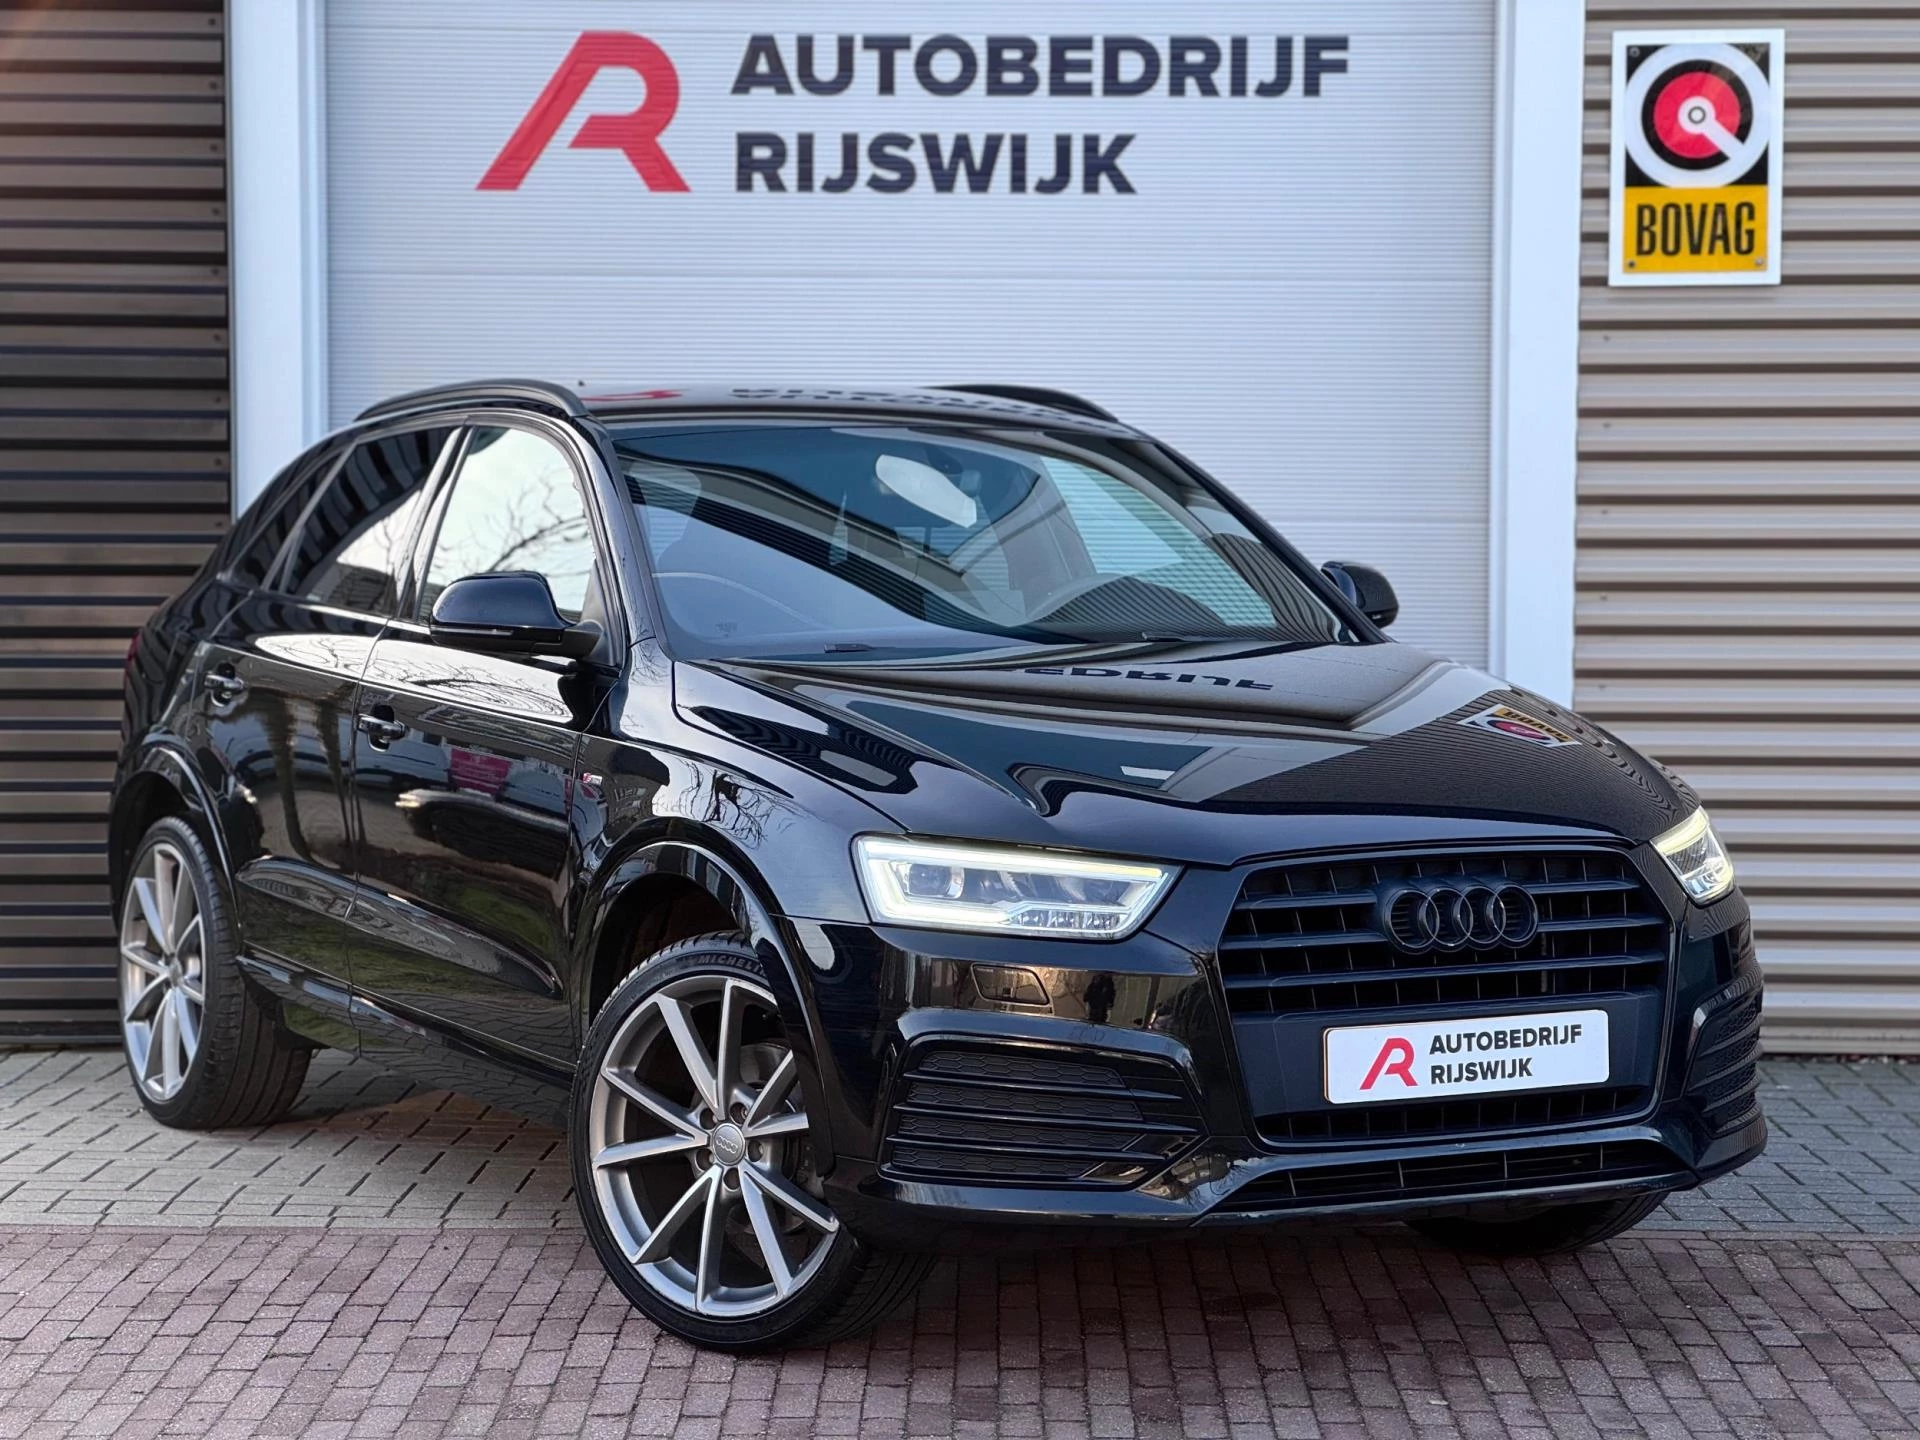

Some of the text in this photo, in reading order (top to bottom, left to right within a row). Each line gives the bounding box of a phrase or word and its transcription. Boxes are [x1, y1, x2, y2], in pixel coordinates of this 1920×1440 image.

[732, 35, 1349, 97] AUTOBEDRIJF
[737, 133, 1137, 195] RIJSWIJK
[1636, 202, 1756, 256] BOVAG
[1429, 1024, 1582, 1055] AUTOBEDRIJF
[1430, 1057, 1533, 1085] RIJSWIJK
